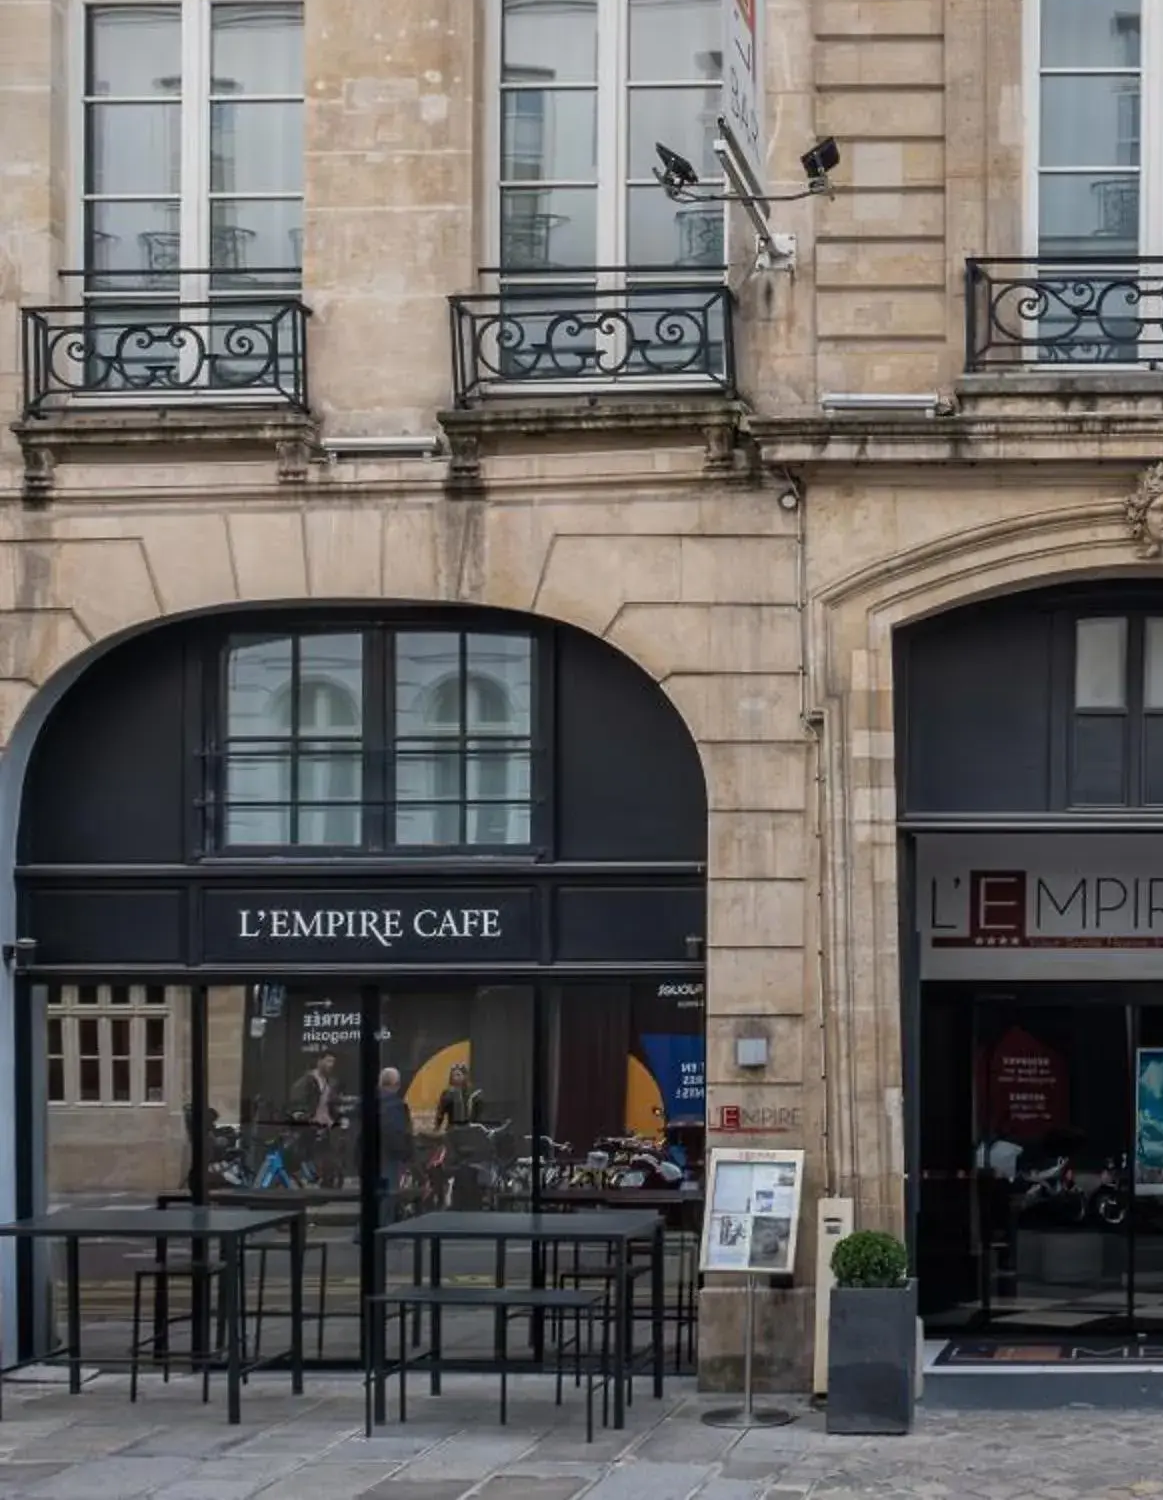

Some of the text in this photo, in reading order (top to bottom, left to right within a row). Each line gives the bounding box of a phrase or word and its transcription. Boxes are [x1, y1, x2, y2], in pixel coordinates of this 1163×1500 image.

[239, 909, 501, 947] L'EMPIRE CAFE
[708, 1105, 802, 1128] L'EMPIRE
